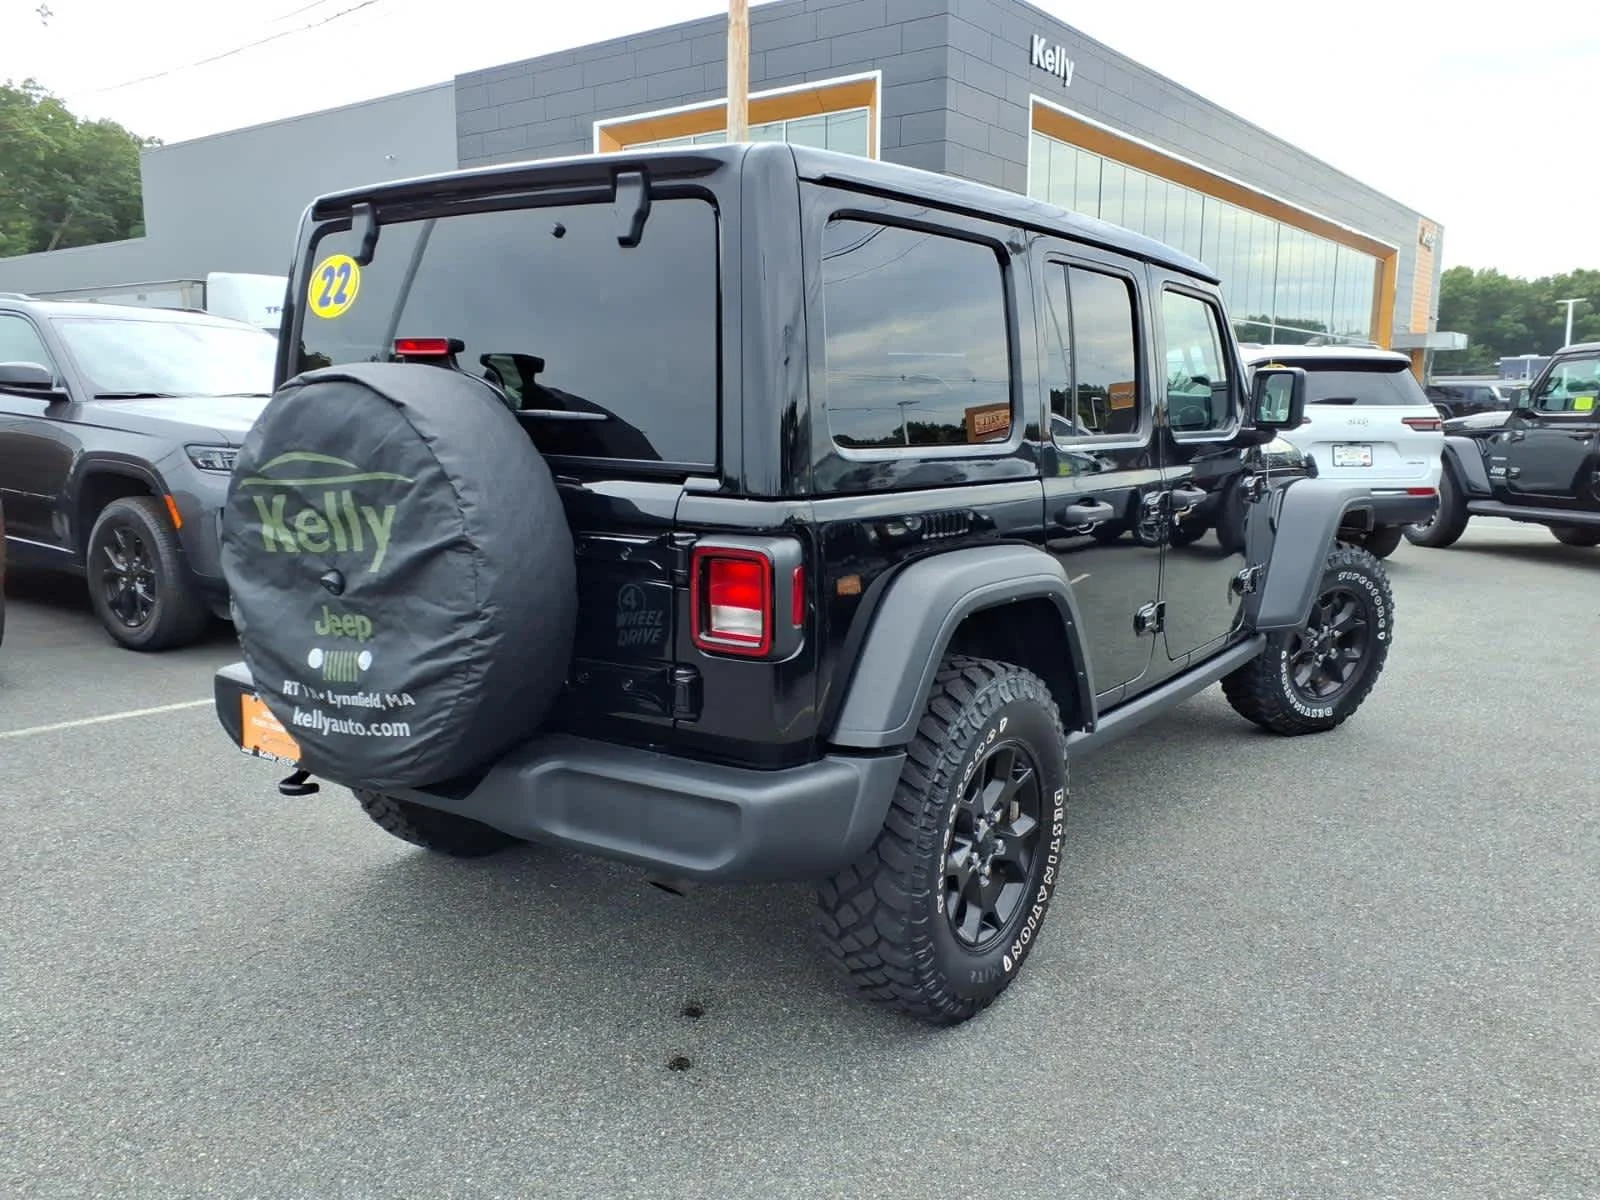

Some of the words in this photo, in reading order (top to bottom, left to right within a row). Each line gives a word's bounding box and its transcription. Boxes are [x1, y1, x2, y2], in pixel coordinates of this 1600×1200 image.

[1031, 33, 1075, 87] Kelly
[318, 262, 352, 308] 22
[252, 489, 397, 573] Kelly
[314, 605, 372, 643] Jeep
[617, 628, 664, 646] DRIVE
[282, 680, 300, 696] RT
[292, 706, 411, 737] kellyauto.com
[1011, 788, 1064, 956] DESTINATION
